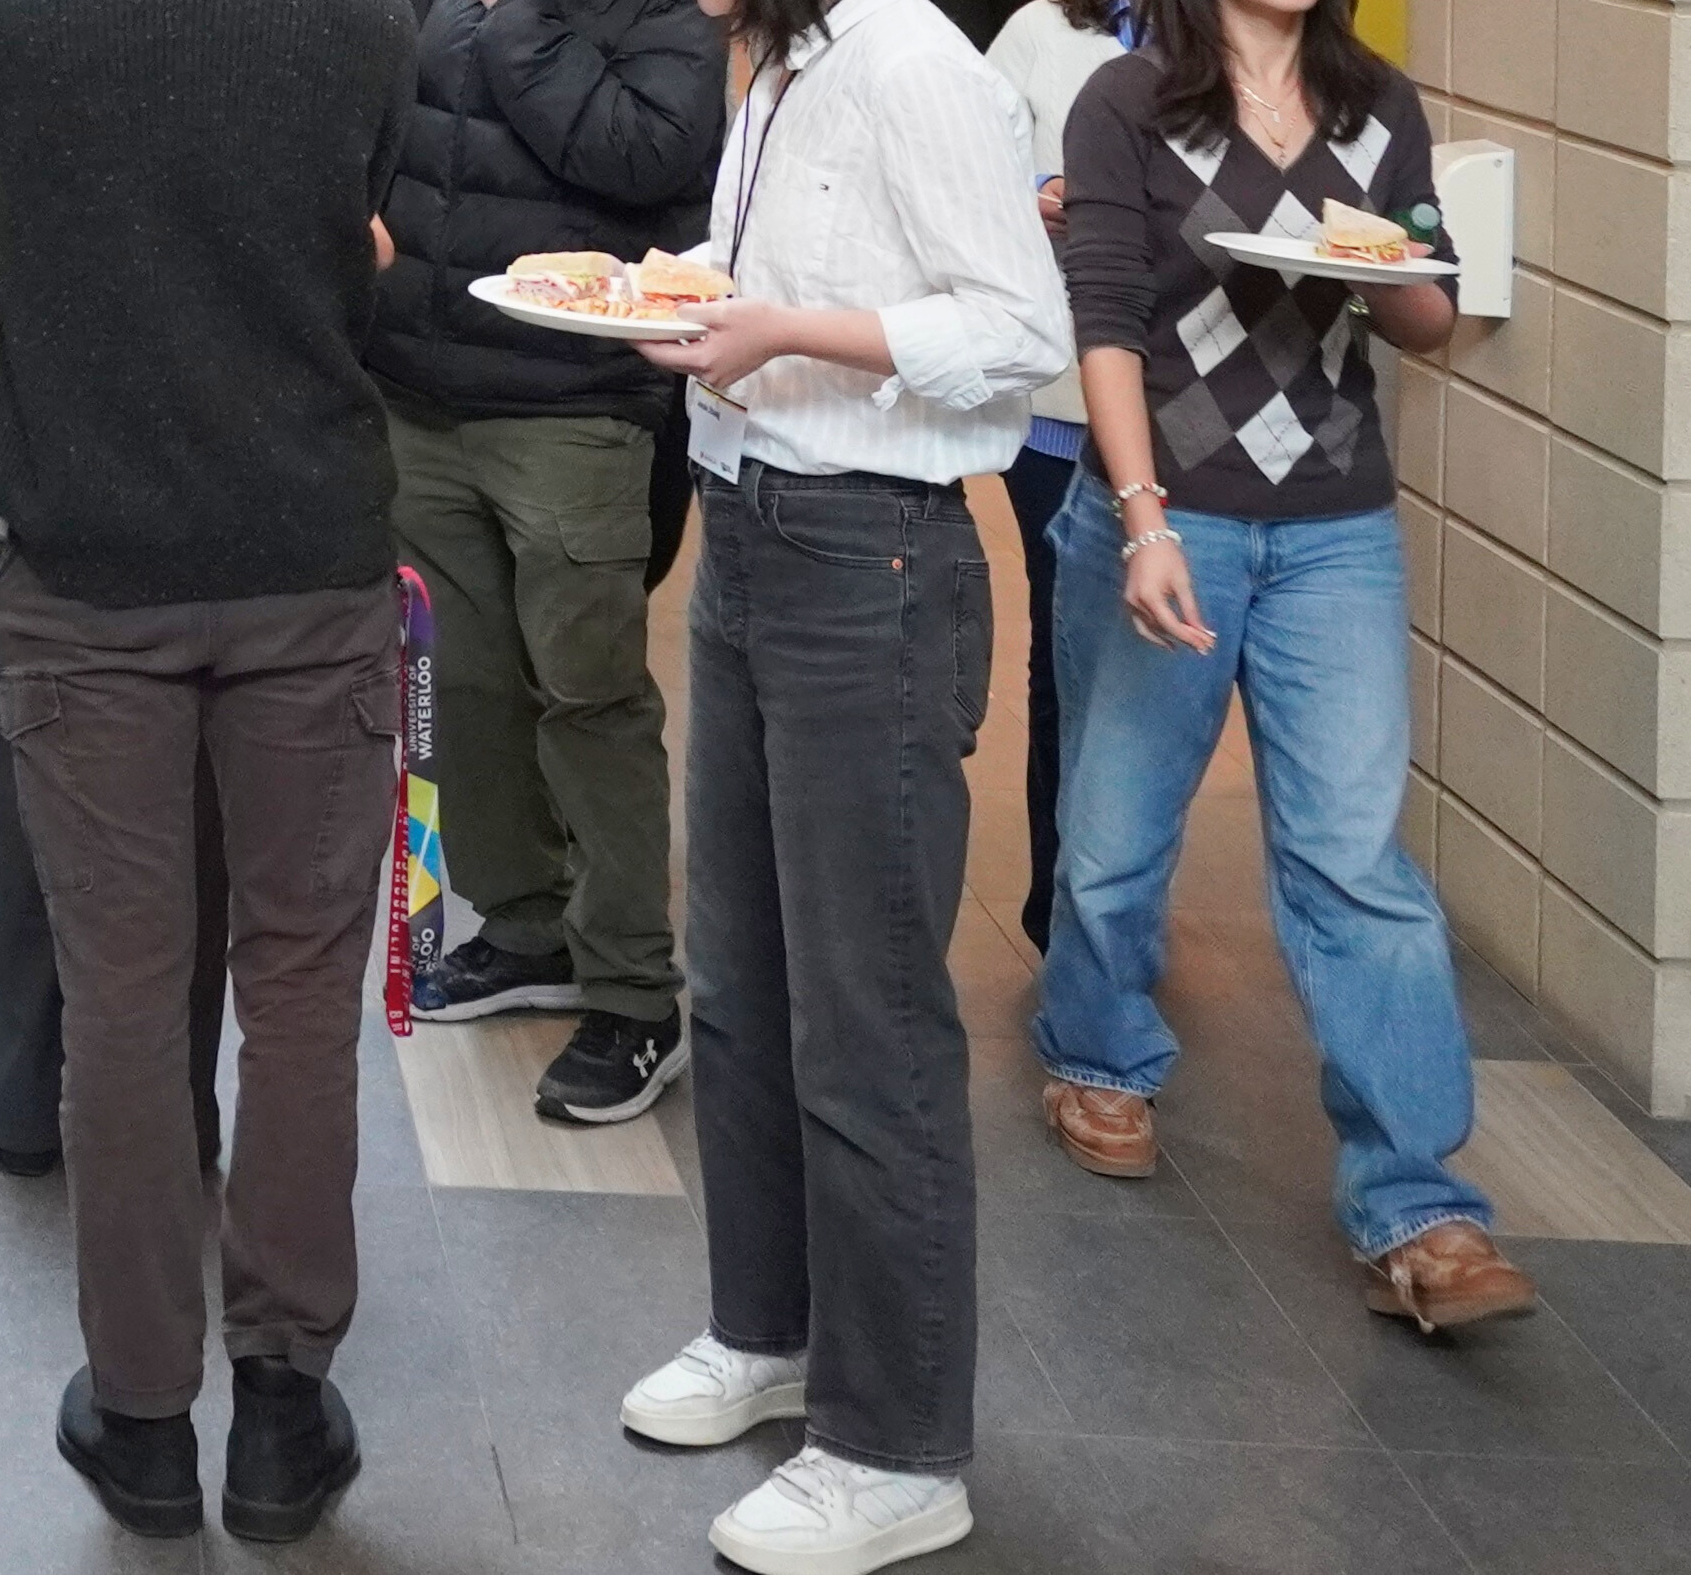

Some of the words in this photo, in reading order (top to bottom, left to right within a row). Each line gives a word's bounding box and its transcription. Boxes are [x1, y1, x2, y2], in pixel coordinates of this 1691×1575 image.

[408, 664, 417, 680] OF
[408, 684, 418, 752] UNIVERSITY
[418, 655, 433, 761] WATERLOO
